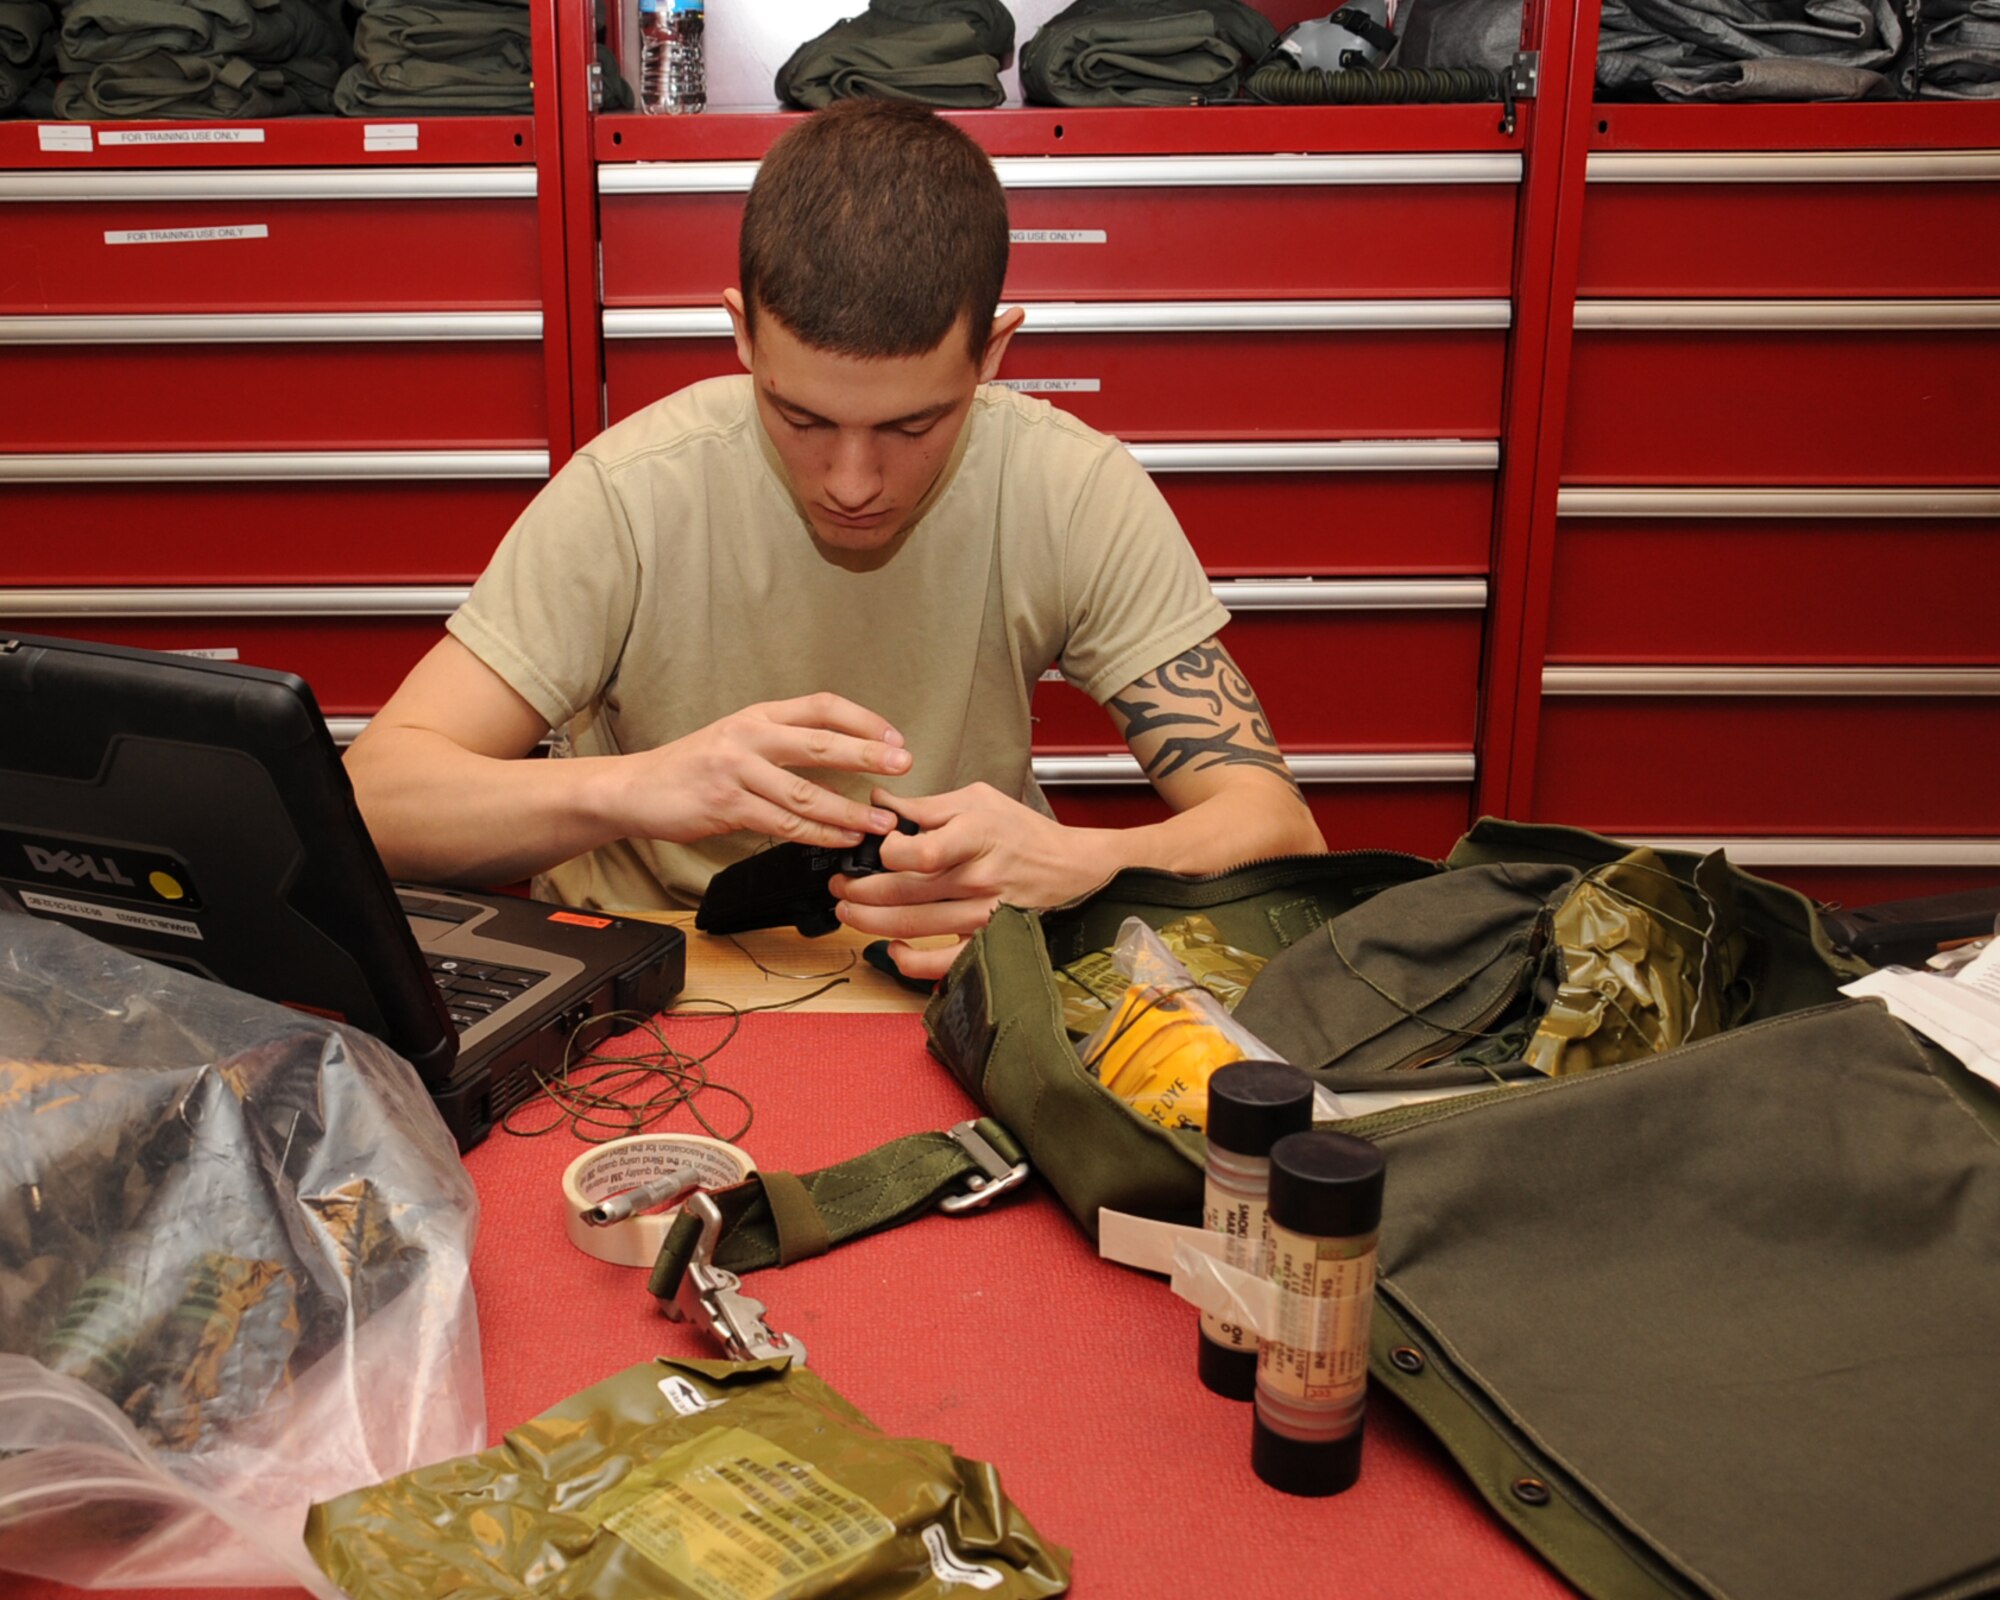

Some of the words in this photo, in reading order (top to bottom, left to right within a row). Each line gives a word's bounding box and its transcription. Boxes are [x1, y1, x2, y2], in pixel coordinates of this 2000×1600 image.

[121, 133, 142, 143] FOR
[143, 132, 190, 142] TRAINING
[192, 131, 212, 141] USE
[213, 131, 240, 141] ONLY
[127, 232, 147, 241] FOR
[149, 230, 194, 240] TRAINING
[196, 229, 216, 239] USE
[218, 228, 244, 237] ONLY
[1027, 232, 1047, 241] USE
[1049, 232, 1076, 241] ONLY
[1022, 381, 1042, 390] USE
[1044, 381, 1071, 390] ONLY
[22, 844, 136, 887] DELL
[1161, 1077, 1188, 1110] DYE
[630, 1144, 644, 1152] the
[645, 1144, 657, 1152] for
[659, 1144, 705, 1159] Association
[620, 1157, 640, 1167] using
[642, 1156, 664, 1166] Blind
[665, 1157, 679, 1166] the
[681, 1159, 692, 1169] for
[625, 1166, 652, 1178] quality
[610, 1172, 624, 1184] 3M
